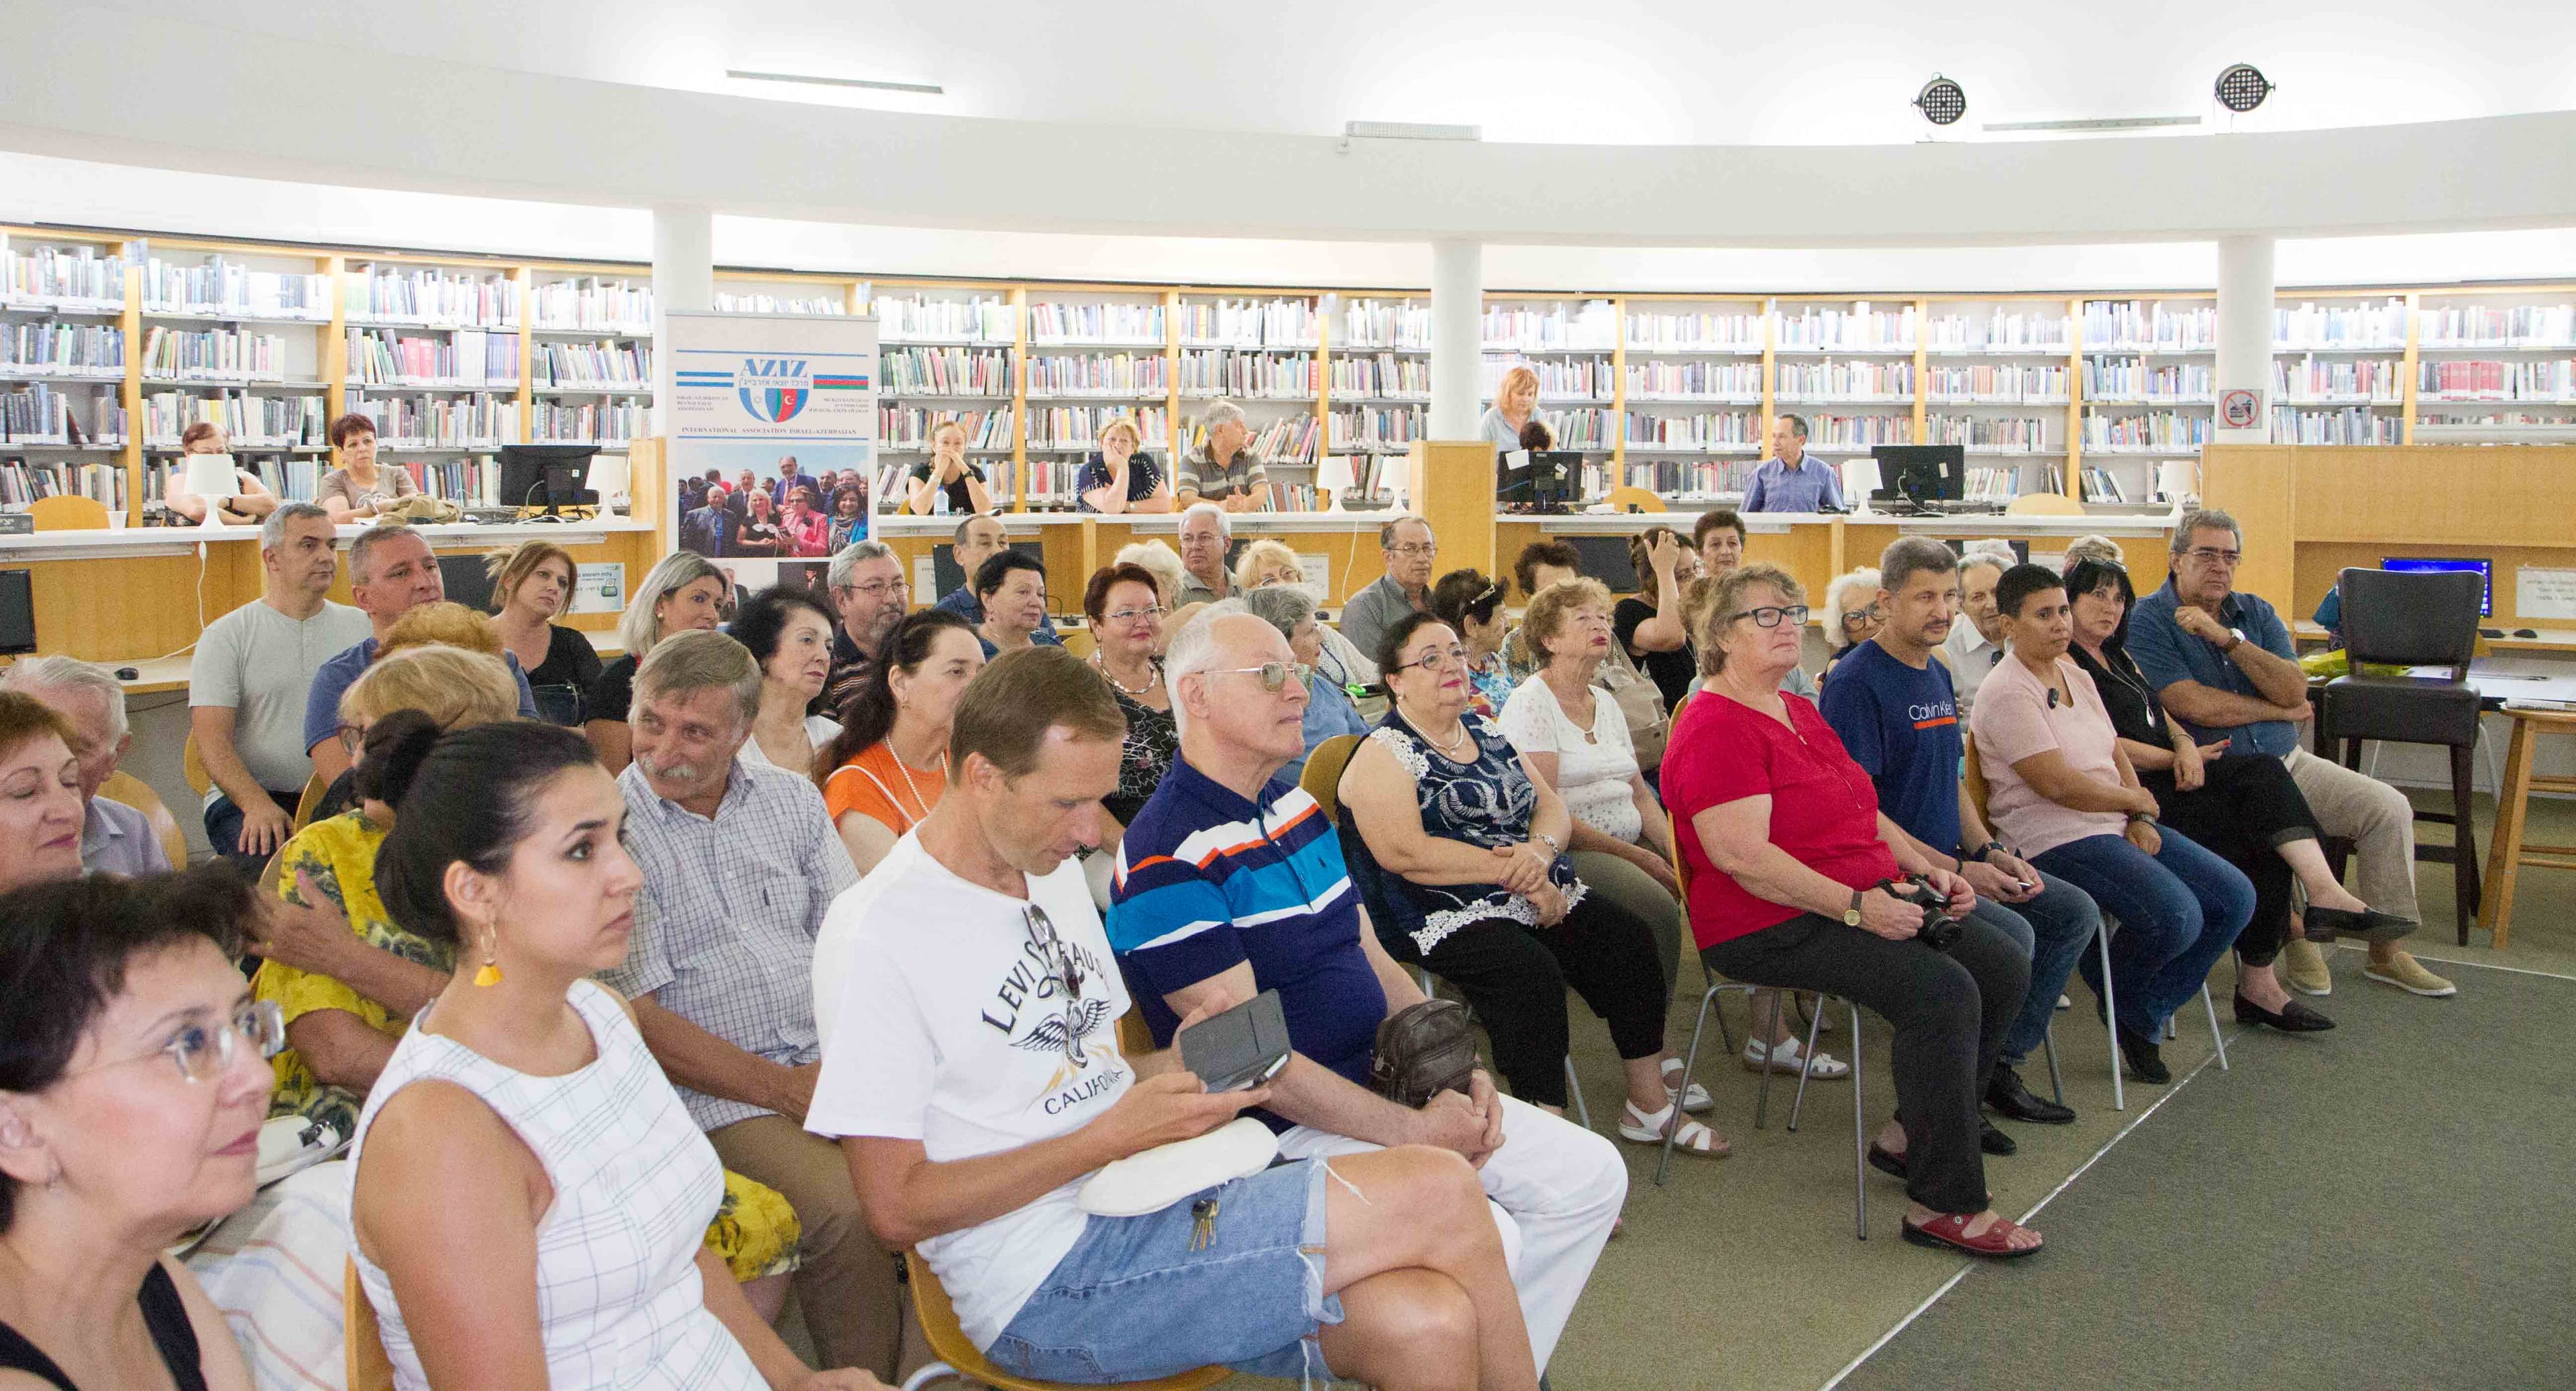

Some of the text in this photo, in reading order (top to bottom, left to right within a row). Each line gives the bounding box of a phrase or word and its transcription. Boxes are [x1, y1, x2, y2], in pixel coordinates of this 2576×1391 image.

[741, 358, 808, 377] AZIZ
[1909, 702, 1939, 720] Calvin
[981, 959, 1036, 1036] LEVI
